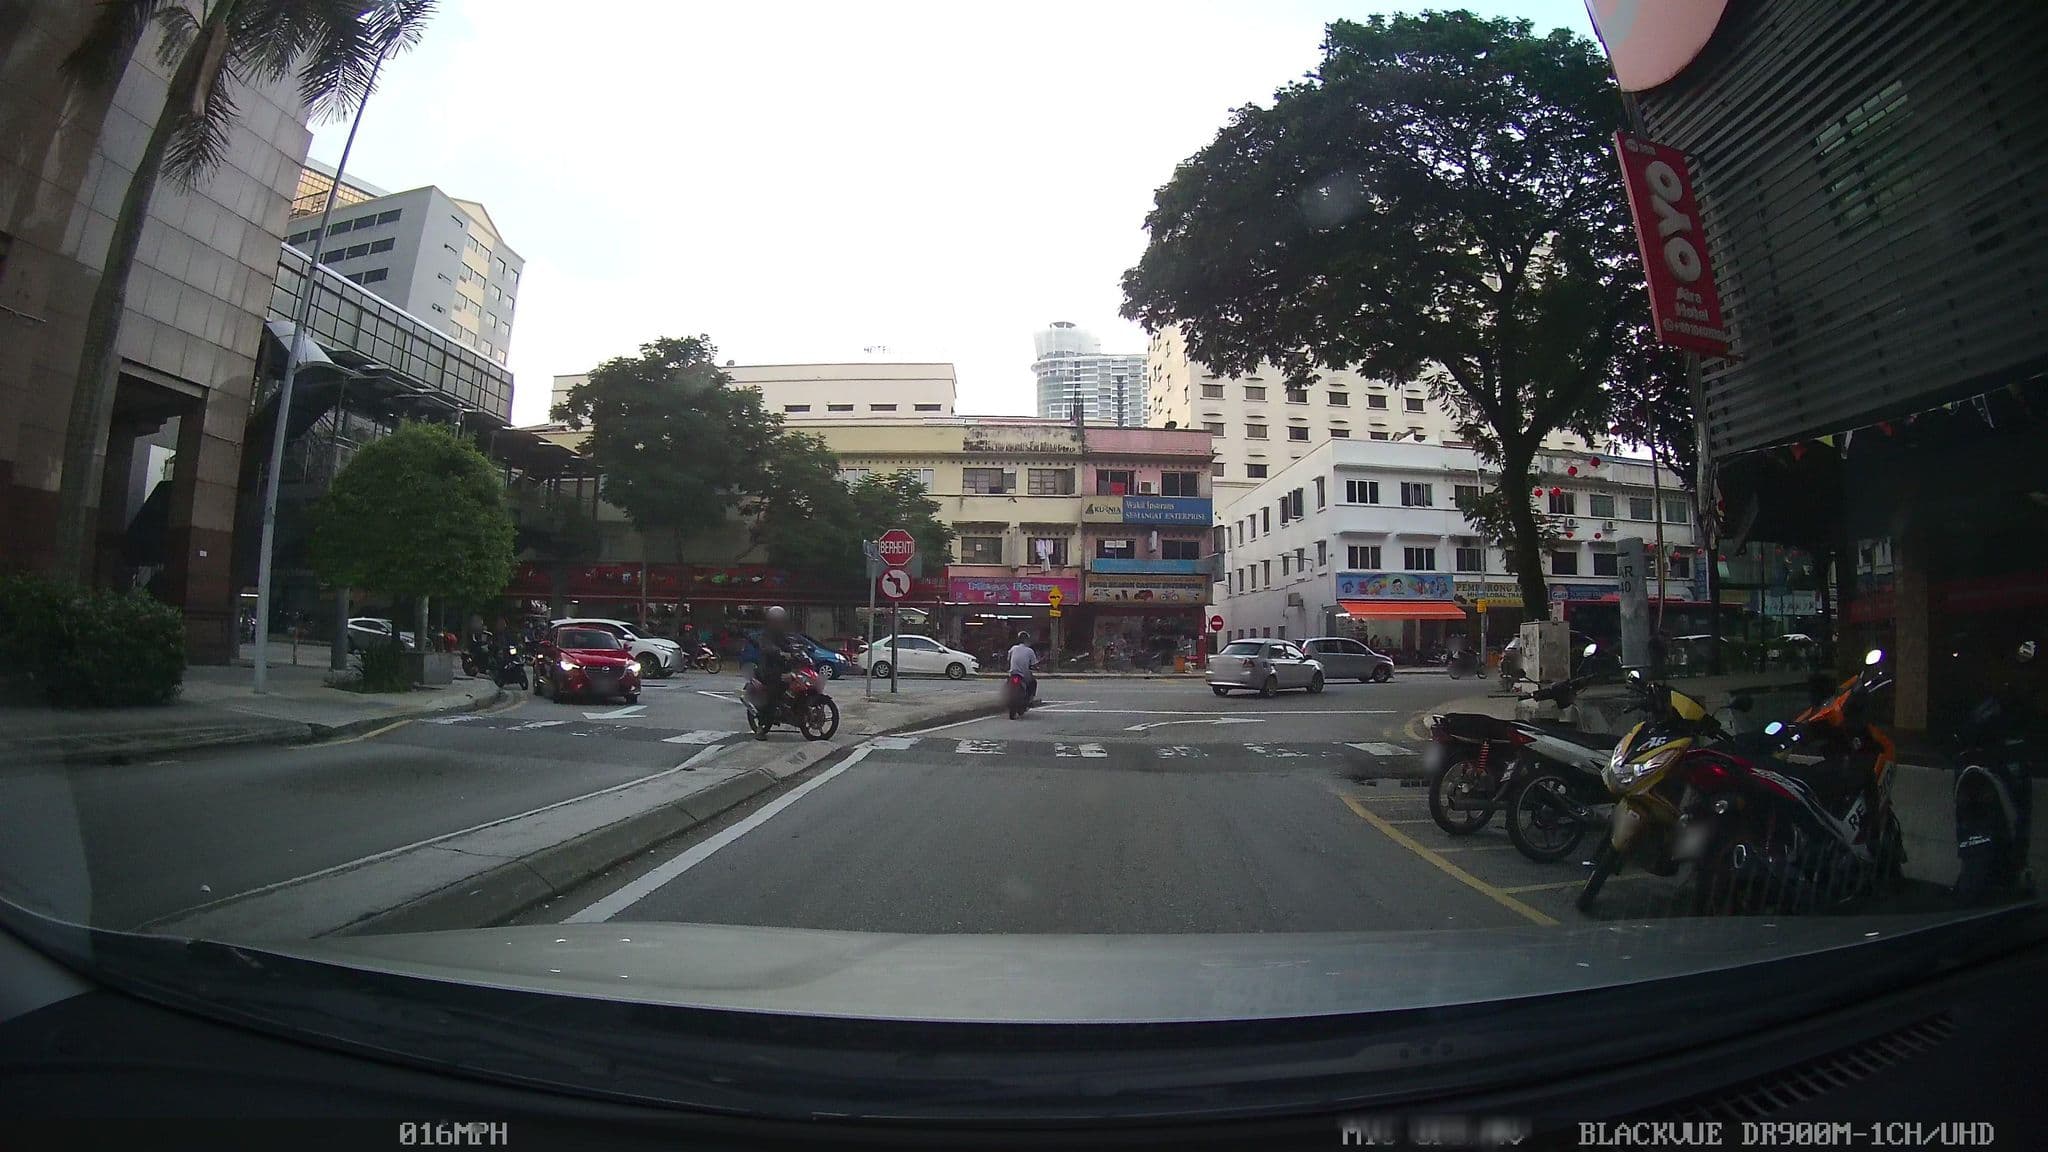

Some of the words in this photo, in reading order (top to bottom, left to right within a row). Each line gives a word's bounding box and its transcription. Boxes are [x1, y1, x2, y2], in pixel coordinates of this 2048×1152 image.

[1645, 160, 1701, 283] OYO
[1165, 512, 1205, 520] ENTERPRISE
[880, 541, 913, 554] BERHENTI
